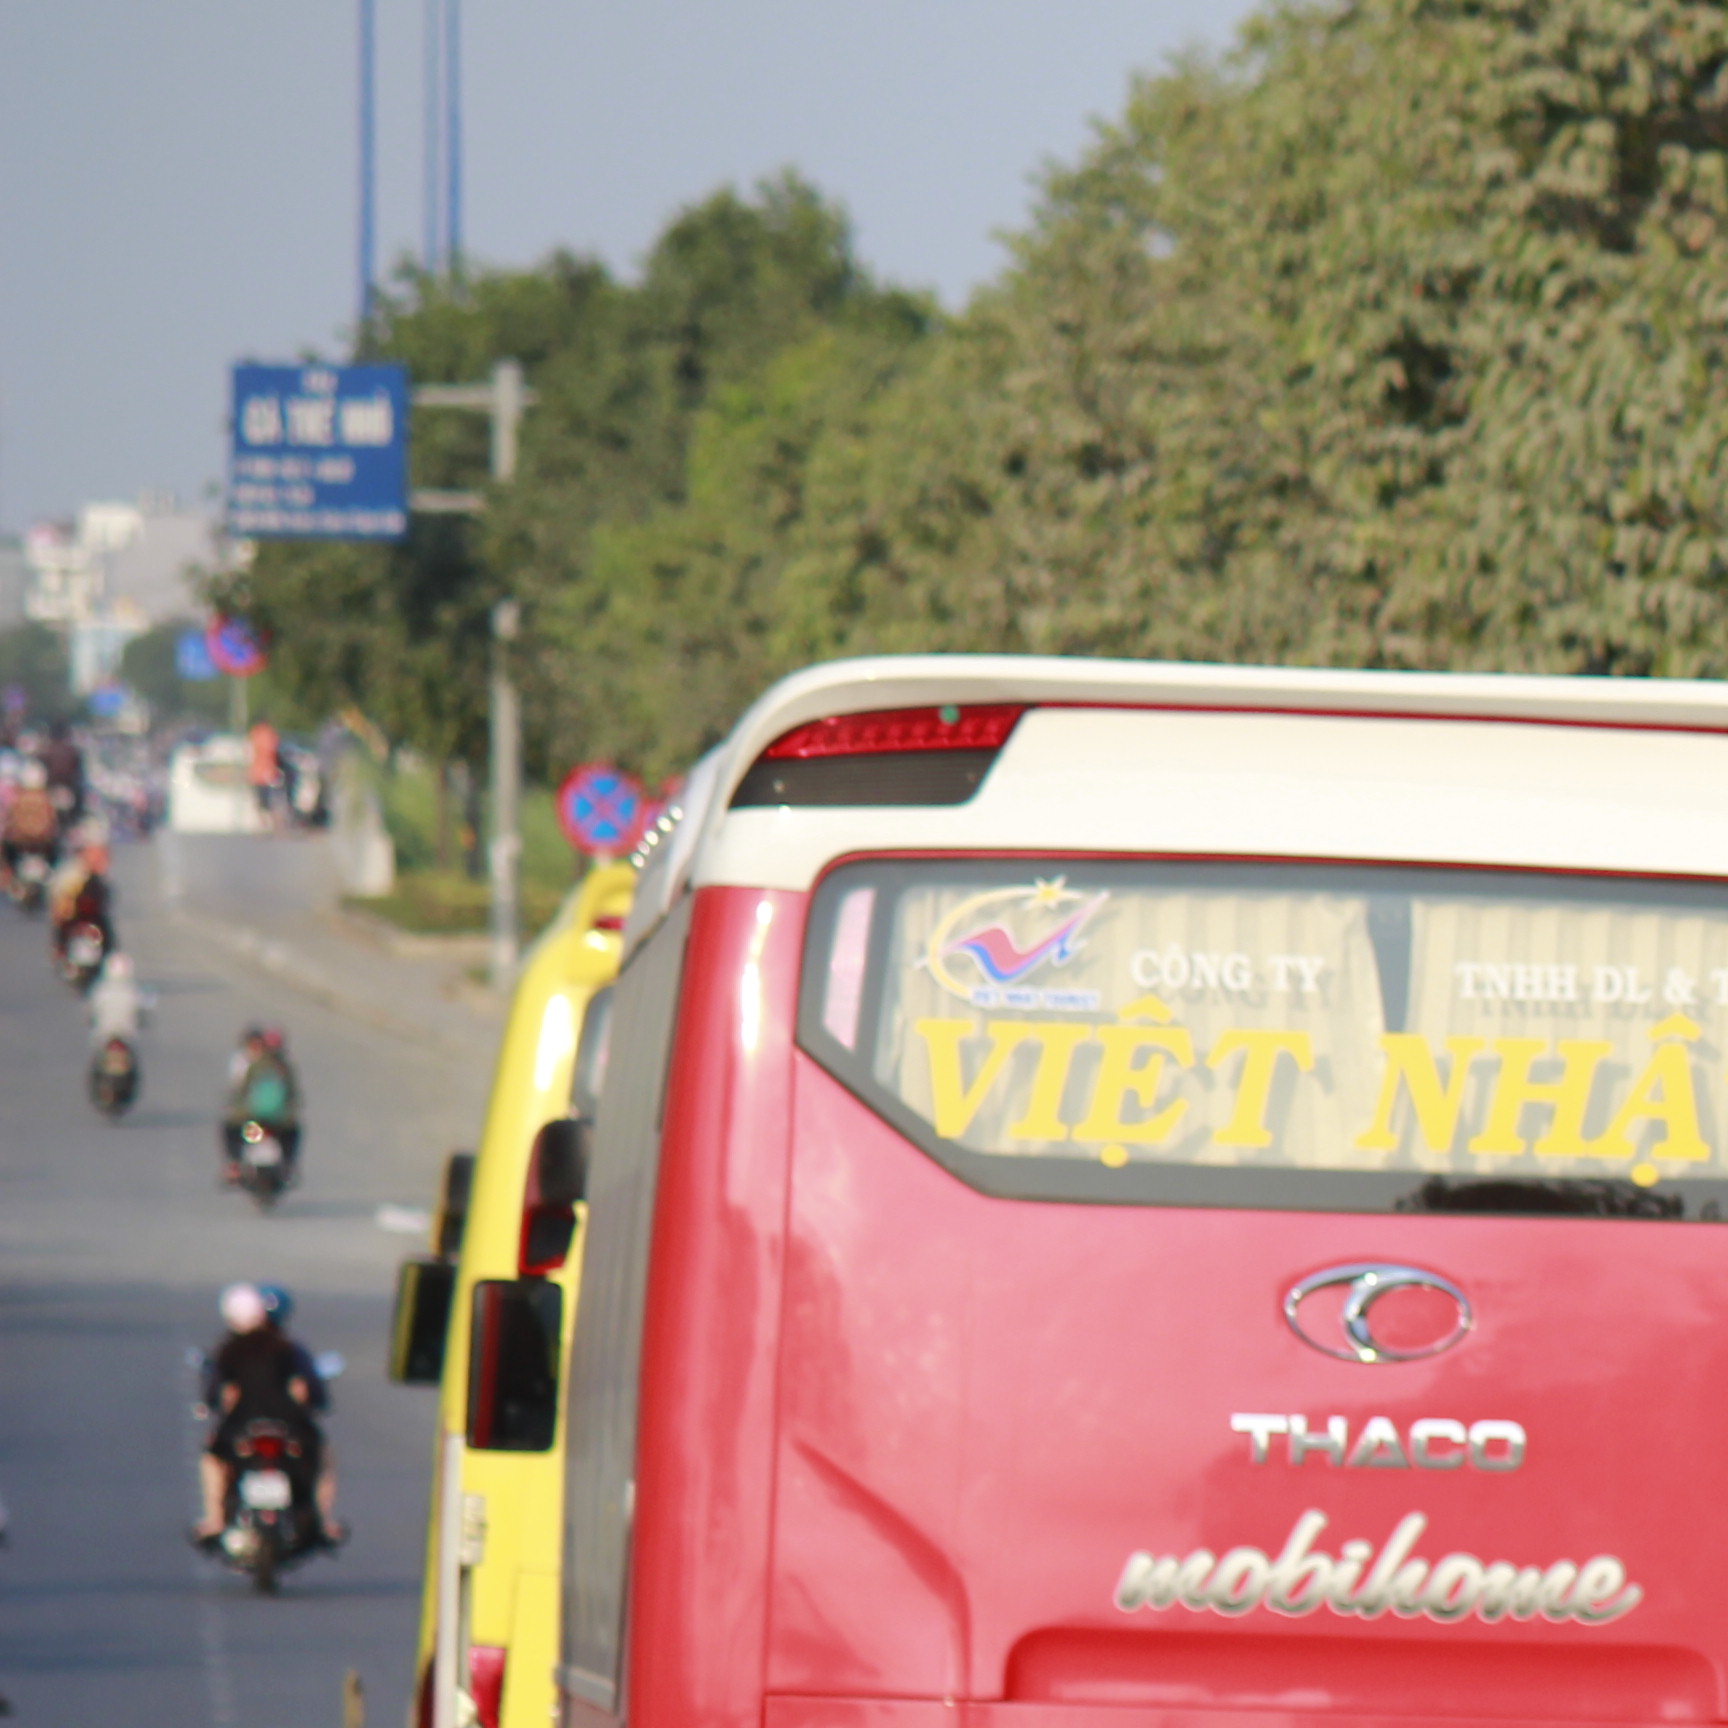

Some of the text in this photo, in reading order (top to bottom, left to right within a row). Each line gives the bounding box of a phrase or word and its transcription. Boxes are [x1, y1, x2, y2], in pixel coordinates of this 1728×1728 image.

[1130, 944, 1324, 991] CÔNG TY
[1455, 962, 1578, 1001] TNHH
[1592, 966, 1650, 1003] DL
[1662, 968, 1695, 1004] &
[915, 995, 1314, 1167] VIỆT
[1231, 1413, 1526, 1471] THACO
[1116, 1508, 1641, 1623] mobihome
